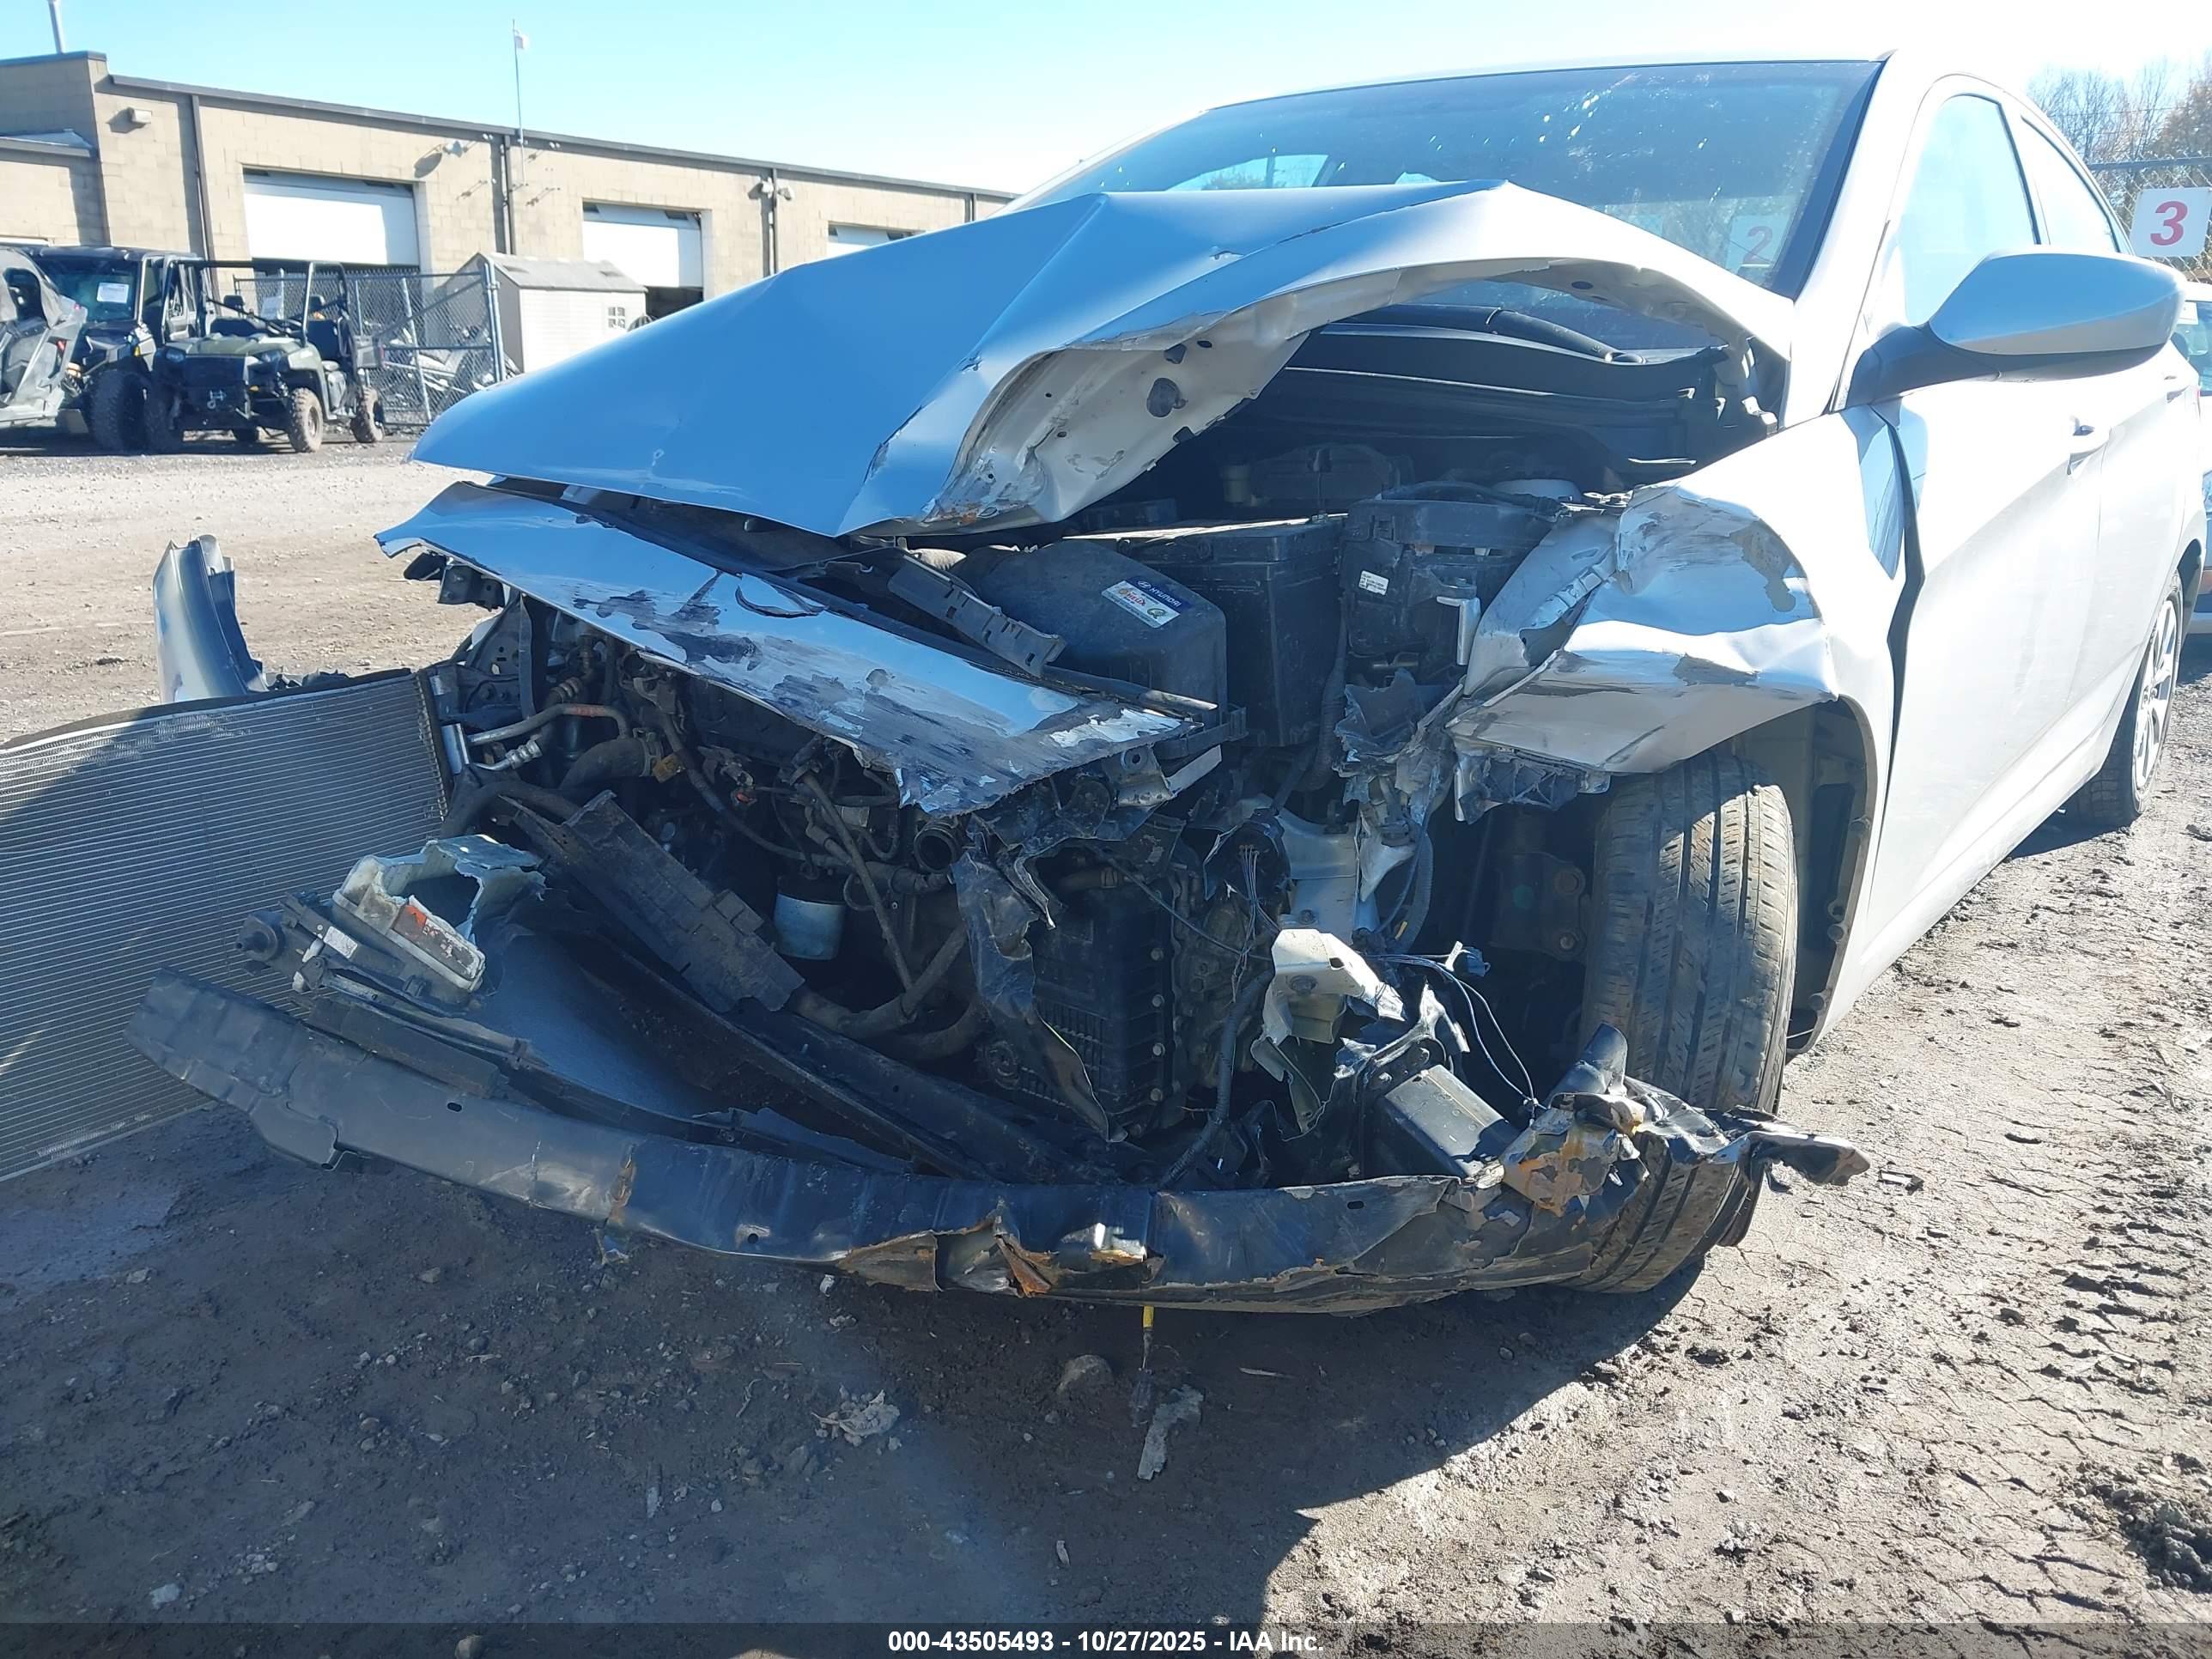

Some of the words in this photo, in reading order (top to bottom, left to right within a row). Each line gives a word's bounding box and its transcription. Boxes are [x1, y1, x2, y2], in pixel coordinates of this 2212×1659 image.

[2150, 200, 2188, 246] 3
[1742, 225, 1773, 266] 2
[1149, 586, 1182, 608] HYUNDAI
